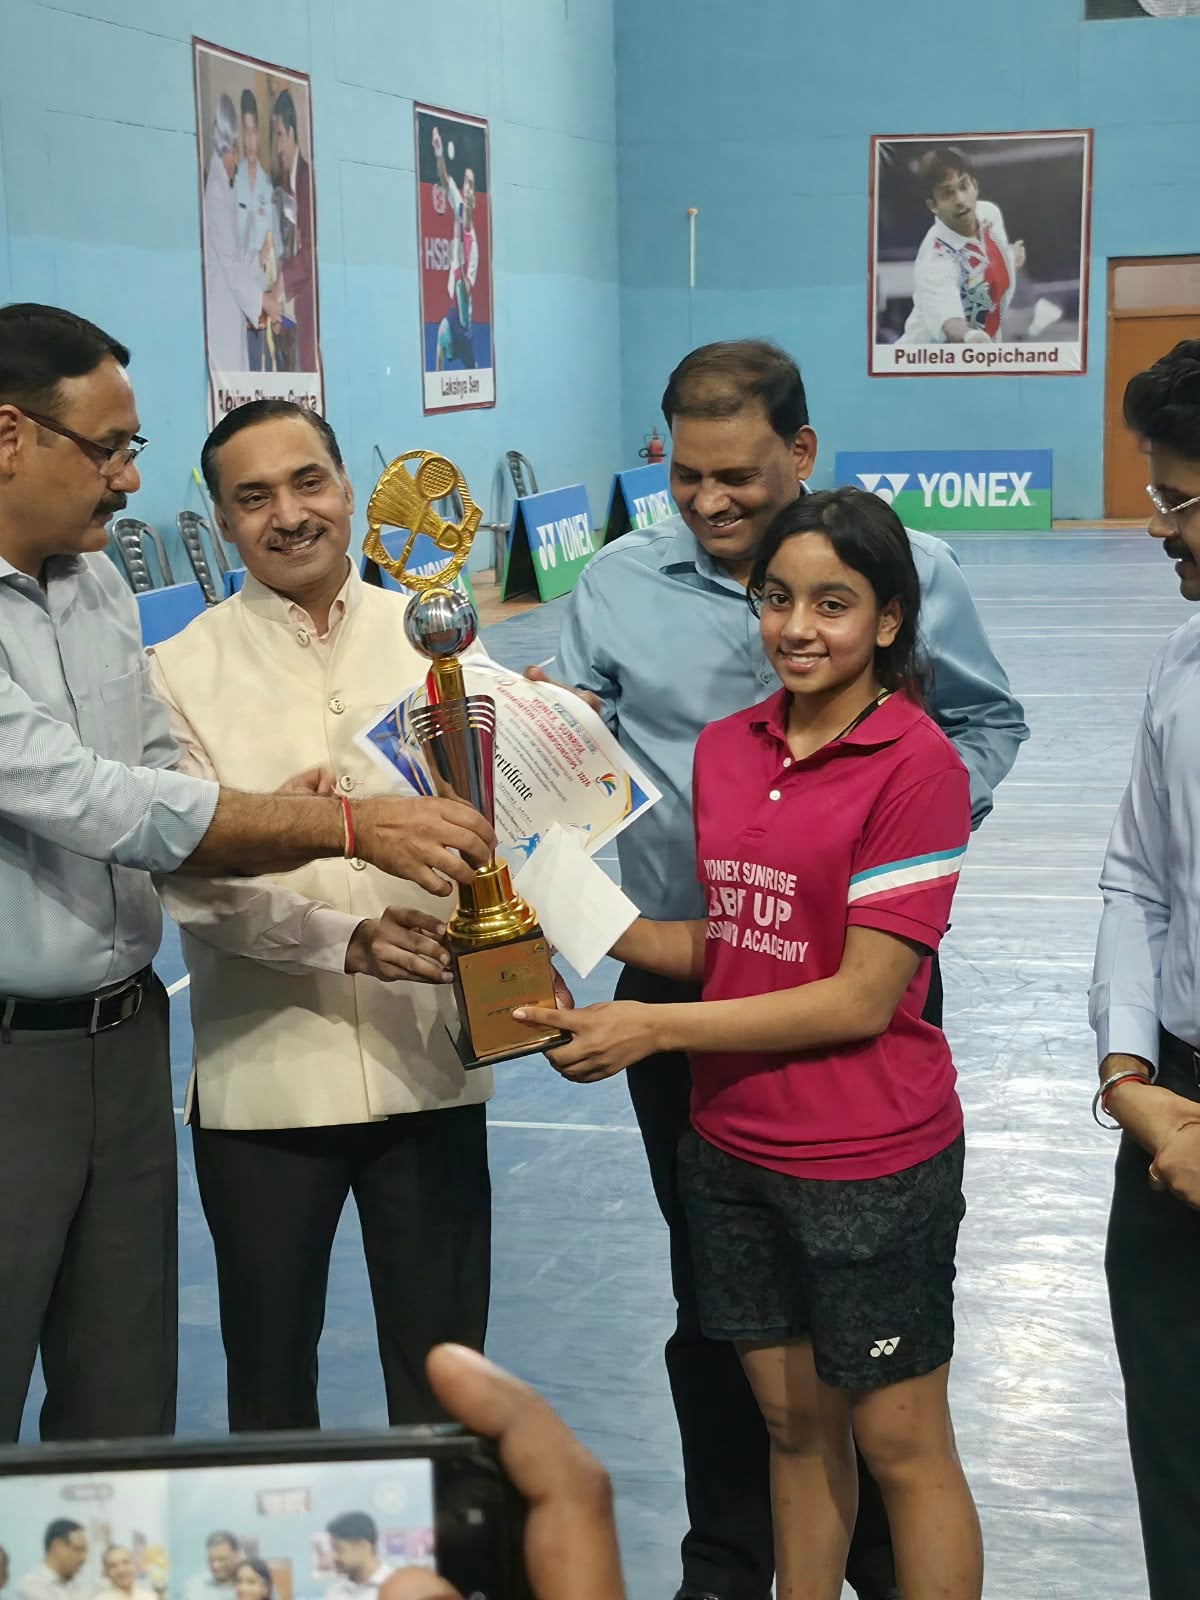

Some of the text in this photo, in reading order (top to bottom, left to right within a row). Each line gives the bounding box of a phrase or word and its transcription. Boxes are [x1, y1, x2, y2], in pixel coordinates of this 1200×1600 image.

[424, 237, 451, 271] HSB
[894, 348, 1058, 367] Pullela Gopichand
[917, 471, 1032, 508] YONEX
[555, 513, 594, 562] YONEX
[494, 743, 533, 801] ertificate
[704, 859, 797, 897] YONEX SUNRISE
[753, 892, 792, 931] UP
[741, 928, 809, 963] ACADEMY
